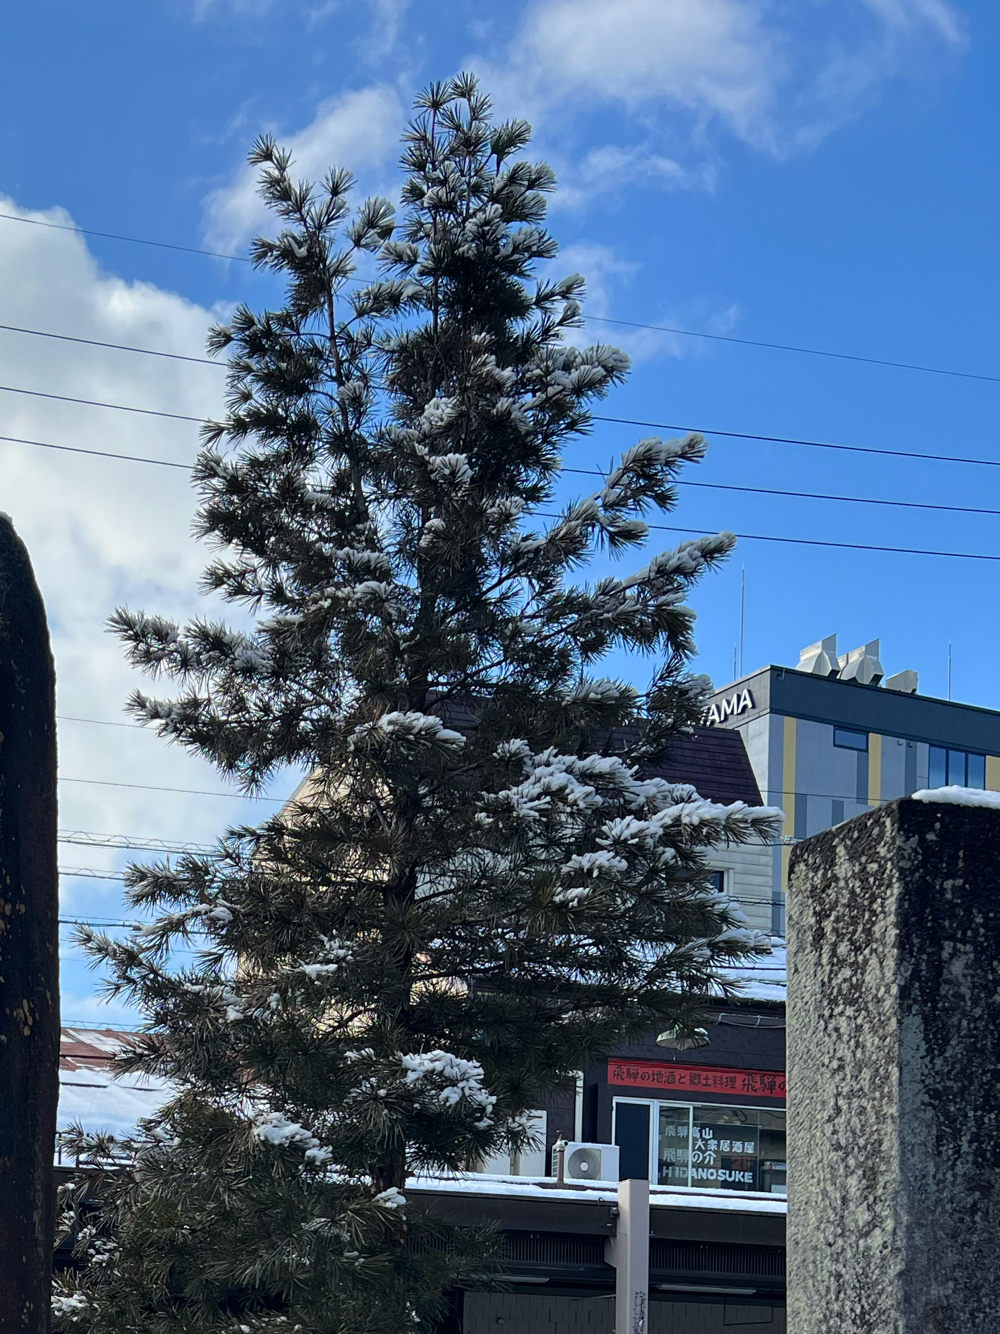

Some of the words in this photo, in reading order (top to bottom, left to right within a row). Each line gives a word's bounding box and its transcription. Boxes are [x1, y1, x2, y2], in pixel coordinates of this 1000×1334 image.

[694, 1138, 755, 1154] 大衆居酒屋
[662, 1165, 753, 1183] HIDANOSUKE
